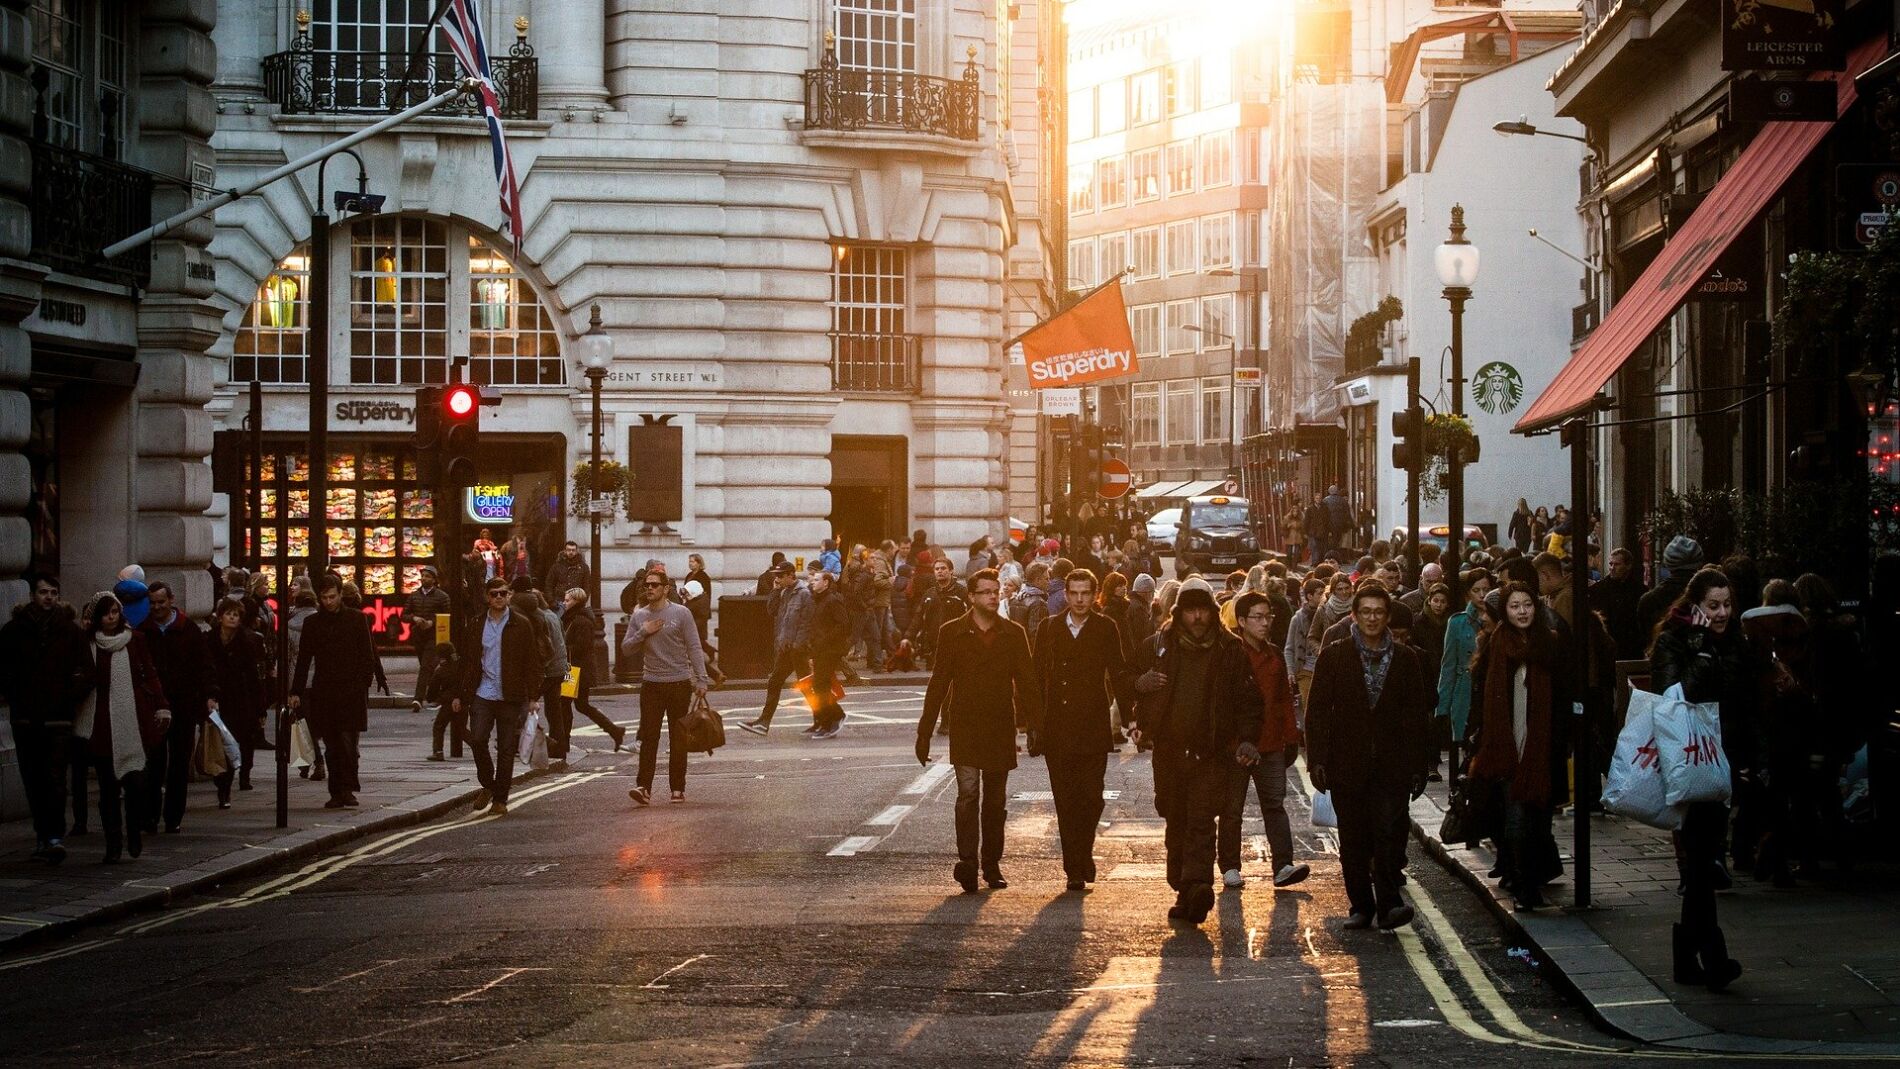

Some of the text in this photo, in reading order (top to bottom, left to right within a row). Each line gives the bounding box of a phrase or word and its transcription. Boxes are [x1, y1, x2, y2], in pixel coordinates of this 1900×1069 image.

[1747, 42, 1824, 52] LEICESTER
[1766, 55, 1806, 65] ARMS
[1031, 348, 1131, 382] Superdry
[603, 372, 641, 382] GENT
[651, 372, 693, 382] STREET
[336, 402, 417, 425] Superdry
[474, 485, 510, 496] T-SHIRT
[1682, 732, 1722, 768] H&M
